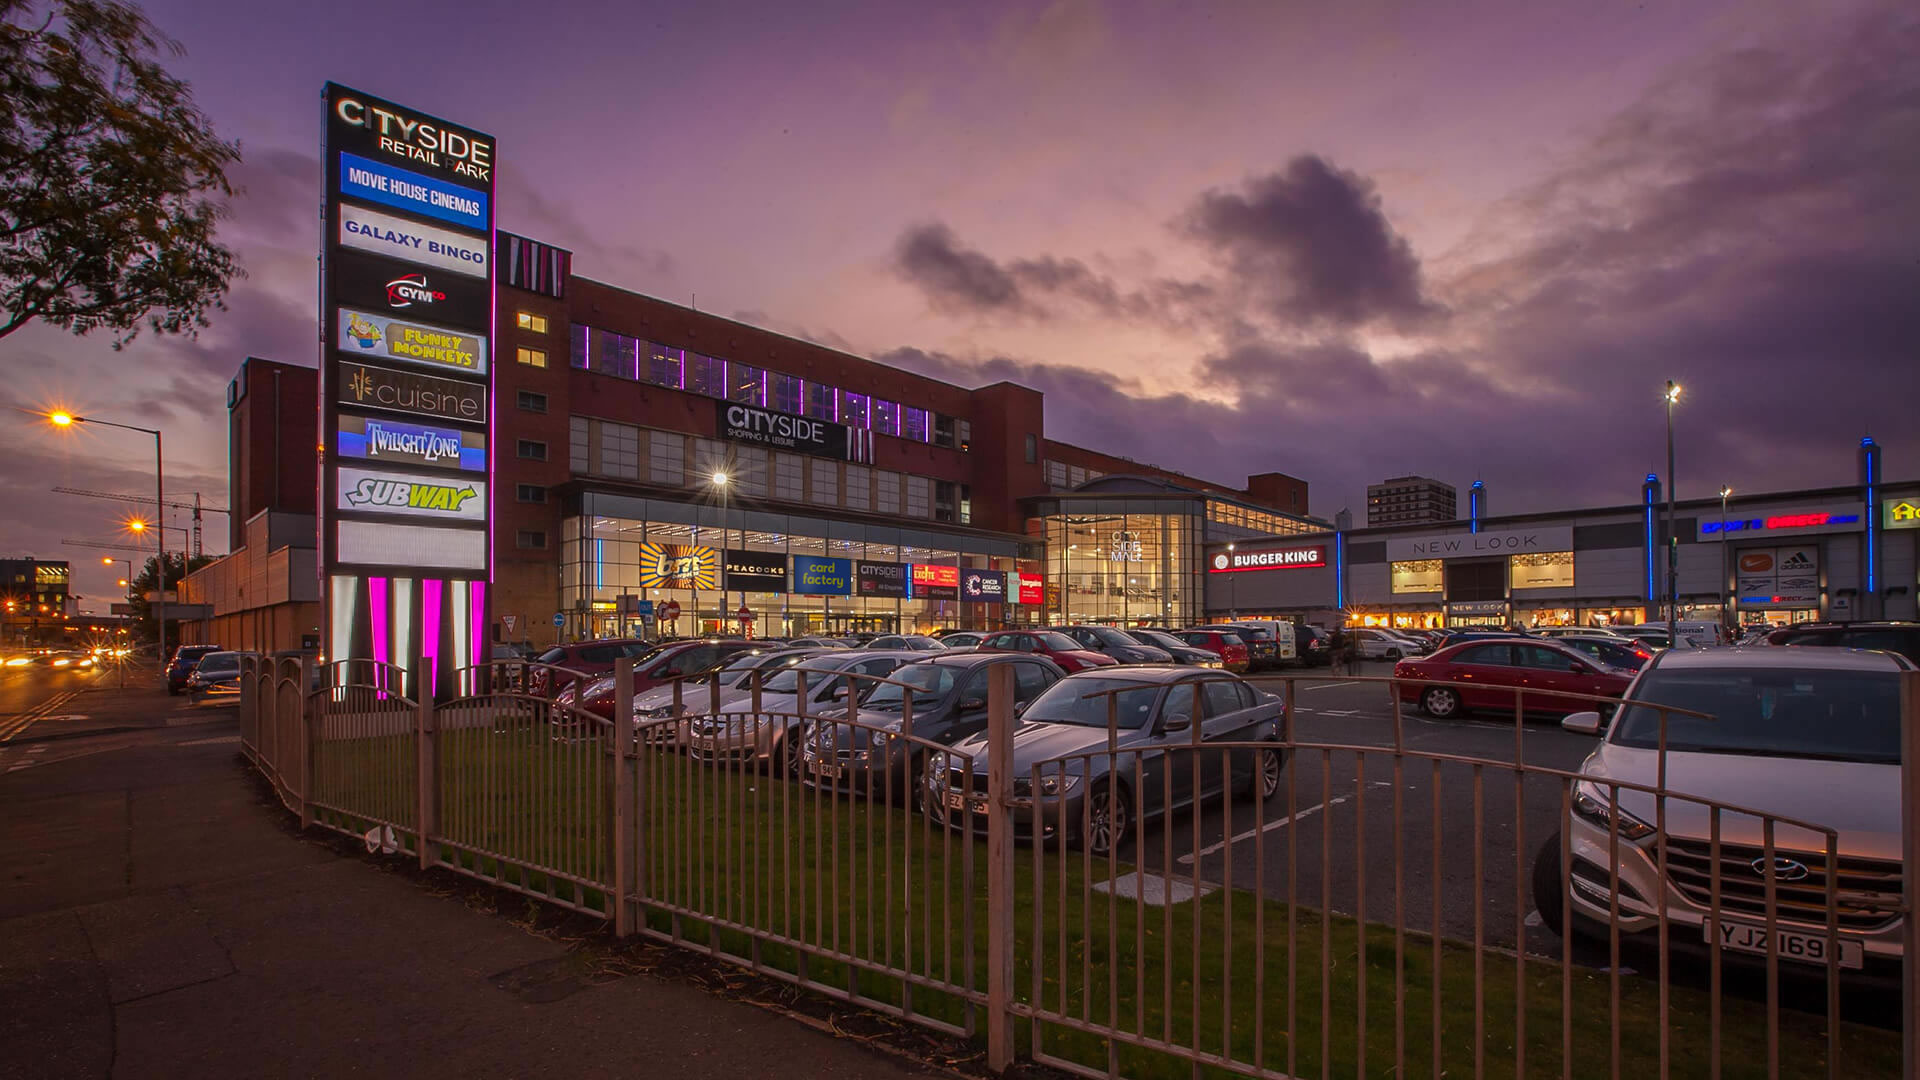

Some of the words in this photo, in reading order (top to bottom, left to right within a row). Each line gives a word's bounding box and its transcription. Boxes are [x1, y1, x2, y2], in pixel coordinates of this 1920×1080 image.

[337, 98, 490, 168] CITYSIDE
[379, 136, 440, 167] RETAIL
[445, 157, 489, 182] PARK
[350, 167, 388, 192] MOVIE
[390, 179, 428, 203] HOUSE
[430, 190, 480, 217] CINEMAS
[345, 220, 422, 249] GALAXY
[428, 241, 484, 264] BINGO
[404, 328, 463, 350] FUNKY
[393, 341, 473, 367] MONKEYS
[376, 385, 478, 417] cuisine
[727, 406, 825, 444] CITYSIDE
[347, 478, 477, 511] SUBWAY
[1413, 540, 1461, 554] NEW
[1474, 535, 1537, 550] LOOK
[726, 564, 785, 574] PEACOCKS
[809, 562, 836, 573] card
[860, 565, 896, 577] CITYSIDE
[1234, 552, 1283, 567] BURGER
[1285, 550, 1318, 563] KING
[802, 573, 844, 589] factory
[1452, 604, 1473, 612] NEW
[1477, 603, 1504, 611] LOOK
[1720, 924, 1768, 950] YJZ
